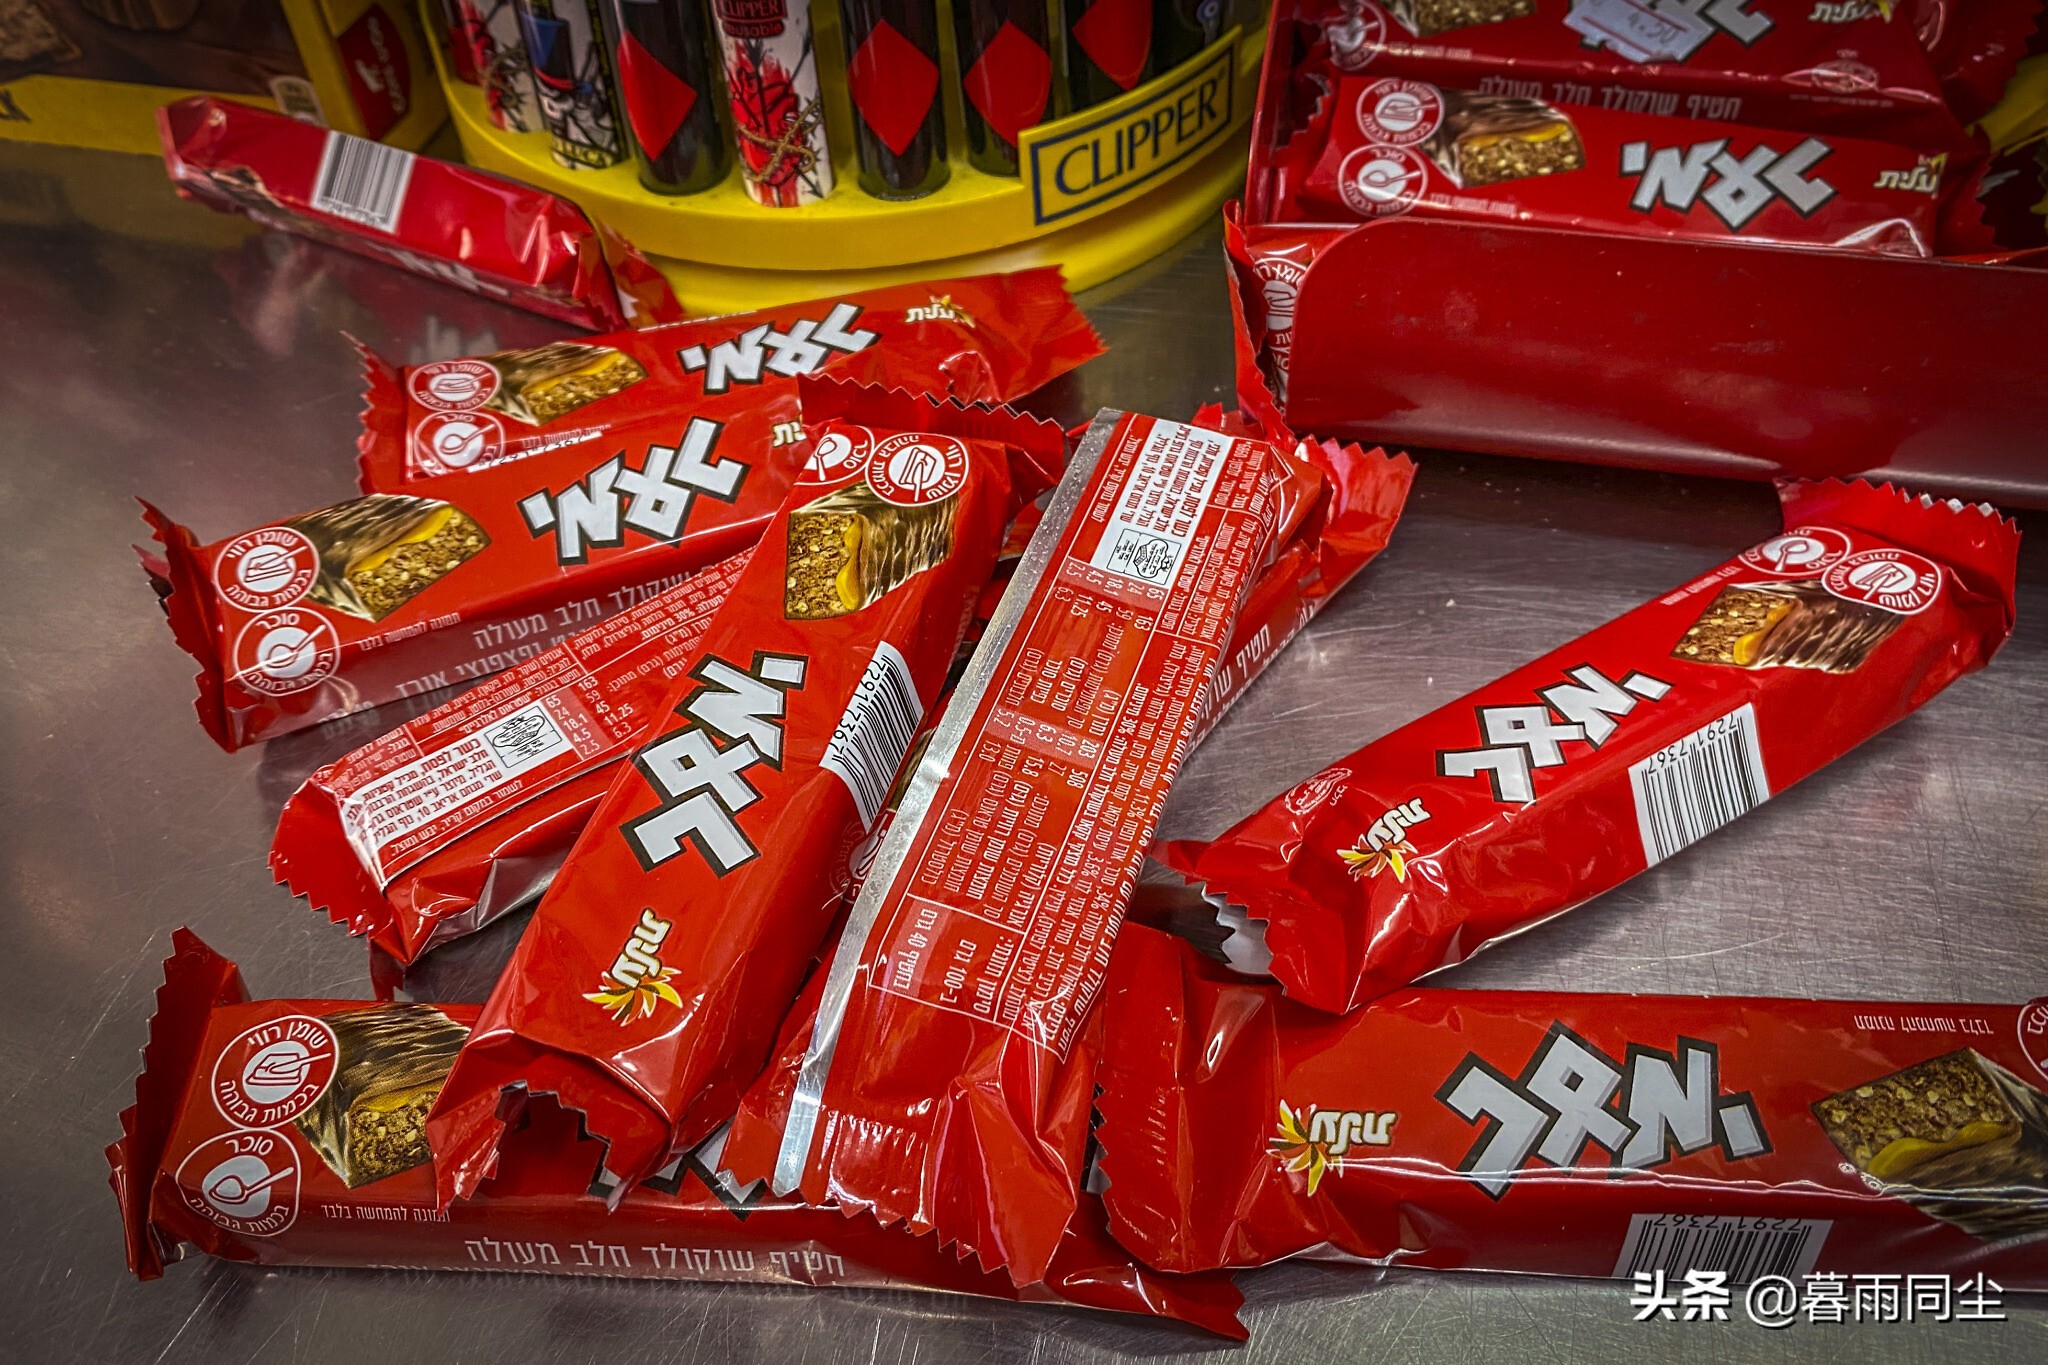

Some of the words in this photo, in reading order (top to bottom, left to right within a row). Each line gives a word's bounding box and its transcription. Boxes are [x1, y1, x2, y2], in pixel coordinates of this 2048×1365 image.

[1602, 85, 1678, 116] שוקולד
[1686, 95, 1742, 120] חטיף
[1055, 79, 1217, 195] CLIPPER
[843, 440, 868, 469] סוכר
[255, 531, 298, 548] שומן
[1084, 568, 1103, 585] 4.5
[1102, 574, 1124, 596] 18.1
[1125, 580, 1144, 595] 24
[560, 596, 602, 626] חלב
[1069, 591, 1093, 619] 11.25
[1094, 598, 1113, 613] 45
[1115, 606, 1132, 620] 59
[256, 613, 300, 630] סוכר
[472, 612, 548, 651] מעולה
[1004, 670, 1032, 708] חלבונים
[1018, 645, 1044, 674] (גרם)
[1053, 584, 1073, 603] 6.3
[1064, 560, 1085, 578] 2.5
[1100, 621, 1124, 650] מתוכן:
[1085, 712, 1109, 737] נתרן
[1132, 612, 1153, 632] 163
[1145, 586, 1164, 601] 65
[1089, 647, 1115, 675] (גרם)
[1236, 624, 1270, 679] חטיף
[1040, 655, 1062, 680] סוכר
[1061, 654, 1088, 683] (גרם)
[395, 671, 448, 700] אורז
[545, 694, 561, 709] 65
[577, 675, 599, 692] 163
[1029, 677, 1052, 705] כפיות
[1050, 679, 1076, 712] סוכרים
[1072, 671, 1102, 716] הפחמימות
[554, 705, 570, 720] 24
[585, 688, 601, 703] 59
[563, 713, 587, 732] 18.1
[594, 699, 610, 714] 45
[571, 727, 591, 744] 4.5
[603, 702, 634, 726] 11.25
[1035, 722, 1057, 743] 6.3
[1063, 713, 1085, 729] סך
[1117, 715, 1138, 736] 30%
[1697, 713, 1737, 746] 7291
[581, 738, 600, 755] 2.5
[611, 720, 632, 738] 6.3
[1054, 730, 1078, 756] 10.7
[1077, 738, 1099, 760] 203
[1104, 734, 1129, 765] מעולה:
[997, 743, 1021, 771] פחות
[1020, 753, 1044, 778] 15.8
[1046, 760, 1066, 776] 27
[1648, 739, 1689, 774] 7367
[984, 768, 1012, 799] (גרם)
[1065, 767, 1088, 790] 508
[1097, 763, 1117, 783] חלב
[920, 835, 957, 888] כולסטרול
[977, 737, 1001, 763] 13.0
[992, 708, 1014, 728] 5.2
[1004, 778, 1033, 809] (גרם)
[1080, 780, 1110, 819] בשוקולד
[971, 795, 998, 829] טראנס
[994, 805, 1019, 837] רוויות
[1022, 791, 1051, 829] מתוכם:
[958, 826, 984, 855] שומן
[1007, 826, 1037, 859] (גרם)
[1071, 816, 1094, 841] קקאו
[979, 833, 1006, 863] שומן
[943, 853, 973, 894] חומצות
[990, 856, 1022, 903] השומנים
[1018, 839, 1057, 892] (קלוריות)
[965, 861, 995, 901] חומצות
[913, 906, 938, 933] גרם
[979, 899, 1003, 920] סך
[1005, 888, 1035, 928] אנרגיה
[906, 930, 928, 949] 40
[885, 945, 922, 991] בחטיף
[936, 963, 968, 1005] ב-100
[953, 938, 977, 964] גרם
[965, 977, 999, 1014] סימון
[983, 934, 1016, 979] תזונתי:
[247, 1024, 282, 1047] רווי
[286, 1021, 328, 1049] שומן
[1854, 1015, 1895, 1031] תמונה
[1901, 1016, 1956, 1033] להמחשה
[1959, 1018, 1994, 1035] בלבד
[220, 1079, 258, 1123] גבוהה
[261, 1083, 320, 1124] בכמות
[225, 1136, 273, 1156] סוכר
[190, 1198, 242, 1231] גבוהה
[246, 1204, 290, 1232] בכמות
[322, 1204, 352, 1219] בלבד
[356, 1203, 407, 1221] להמחשה
[464, 1236, 560, 1265] מעולה
[569, 1240, 631, 1268] חלב
[642, 1241, 756, 1274] שוקולד
[770, 1248, 845, 1277] חטיף
